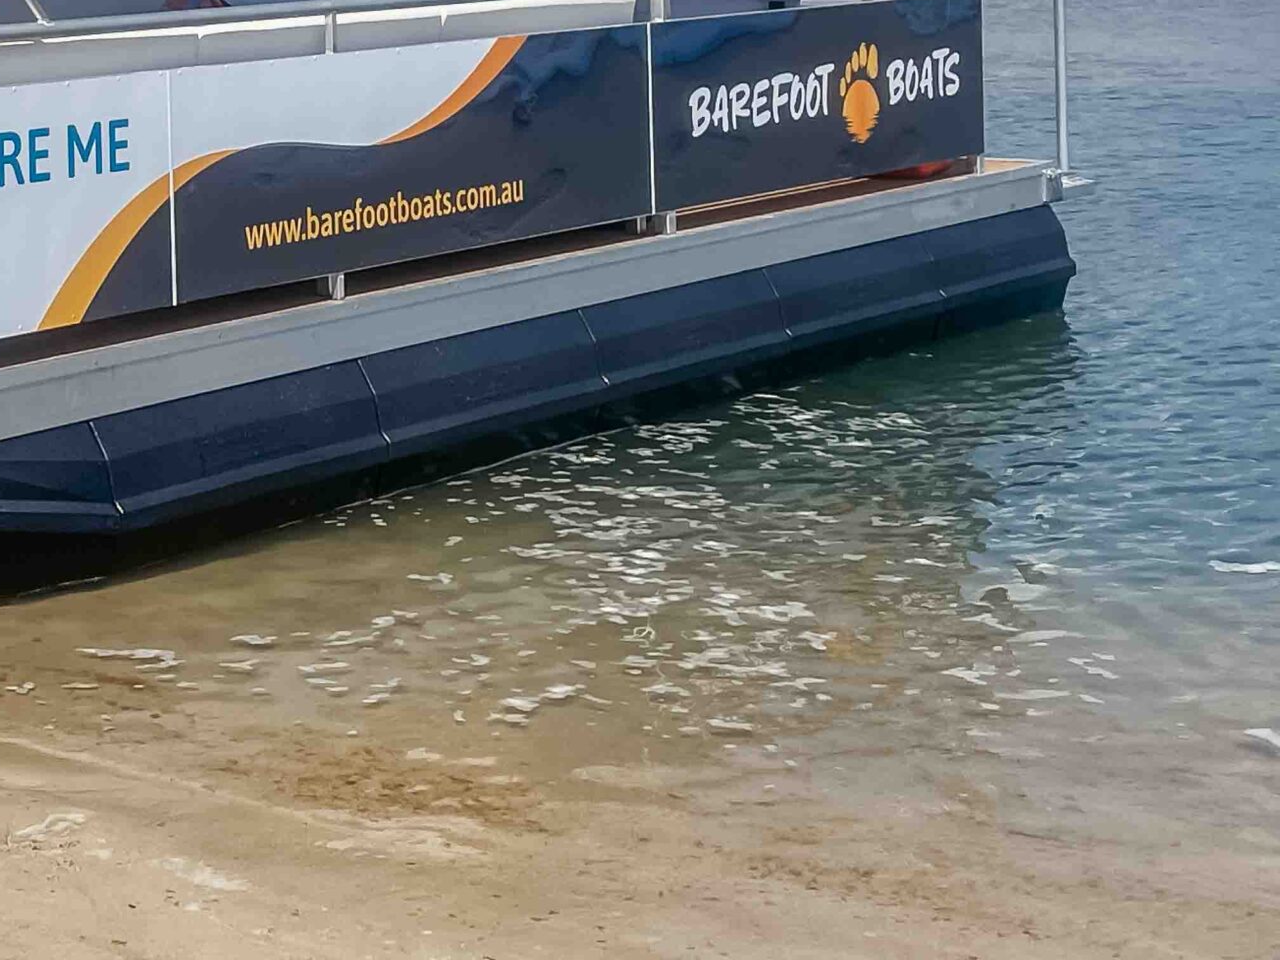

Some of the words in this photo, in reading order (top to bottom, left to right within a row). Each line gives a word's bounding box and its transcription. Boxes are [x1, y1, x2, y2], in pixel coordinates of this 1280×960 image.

[689, 63, 835, 138] BAREFOOT
[886, 47, 960, 105] BOATS
[67, 118, 130, 179] ME
[244, 179, 524, 251] www.barefootboats.com.au
